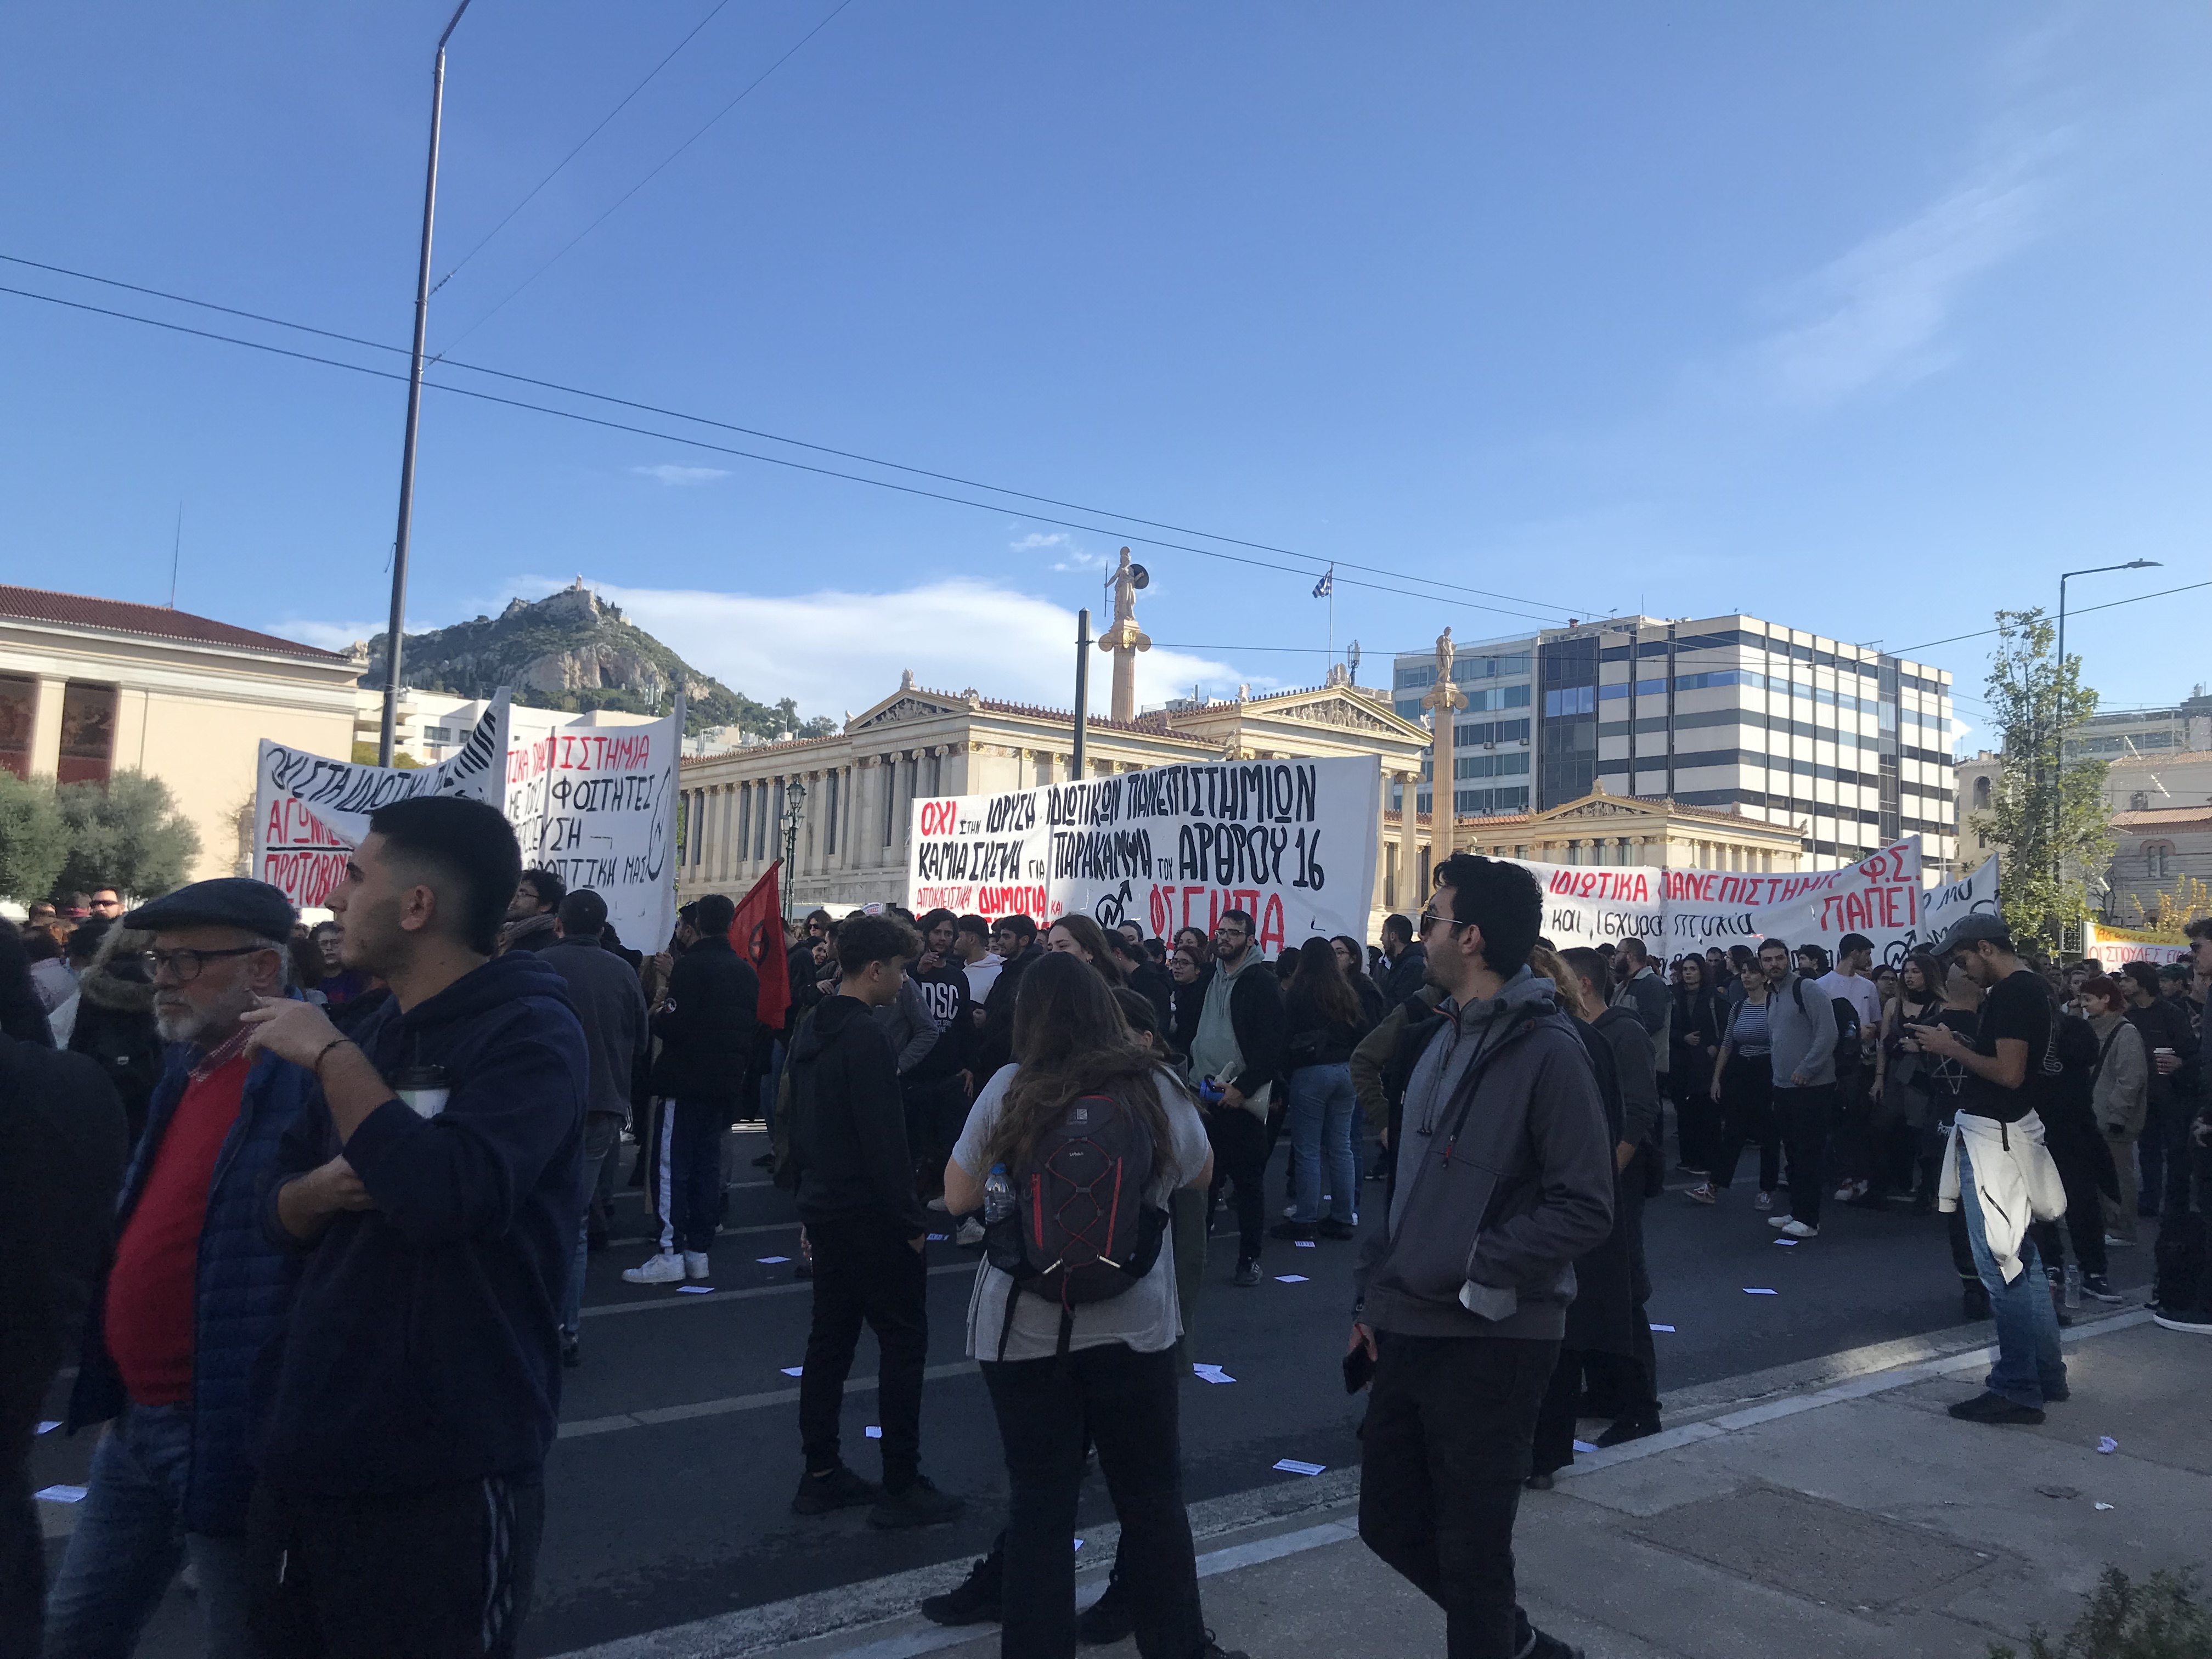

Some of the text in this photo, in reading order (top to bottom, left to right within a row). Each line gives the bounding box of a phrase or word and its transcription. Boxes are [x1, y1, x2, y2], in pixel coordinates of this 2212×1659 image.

[552, 775, 656, 812] ΦΟΙΤΗΤΕΣ
[921, 800, 956, 836] ΟΧΙ
[959, 820, 981, 834] ΣΤΗΝ
[986, 792, 1036, 834] ΙΔΡΥΣΗ
[918, 822, 1325, 891] ΚΑΜΙΑ ΣΚΕΨΗ ΓΙΑ ΠΑΡΑΚΑΜΨΗ ΤΟΥ ΑΡΘΡΟΥ 16
[916, 885, 1063, 918] ΑΠΟΚΛΕΙΣΤΙΚΑ ΔΗΜΟΣΙΑ ΚΑΙ
[1549, 870, 1648, 902] ΙΔΙΩΤΙΚΑ
[1820, 886, 1916, 933] ΠΑΠΕΙ
[922, 983, 959, 1020] DSC
